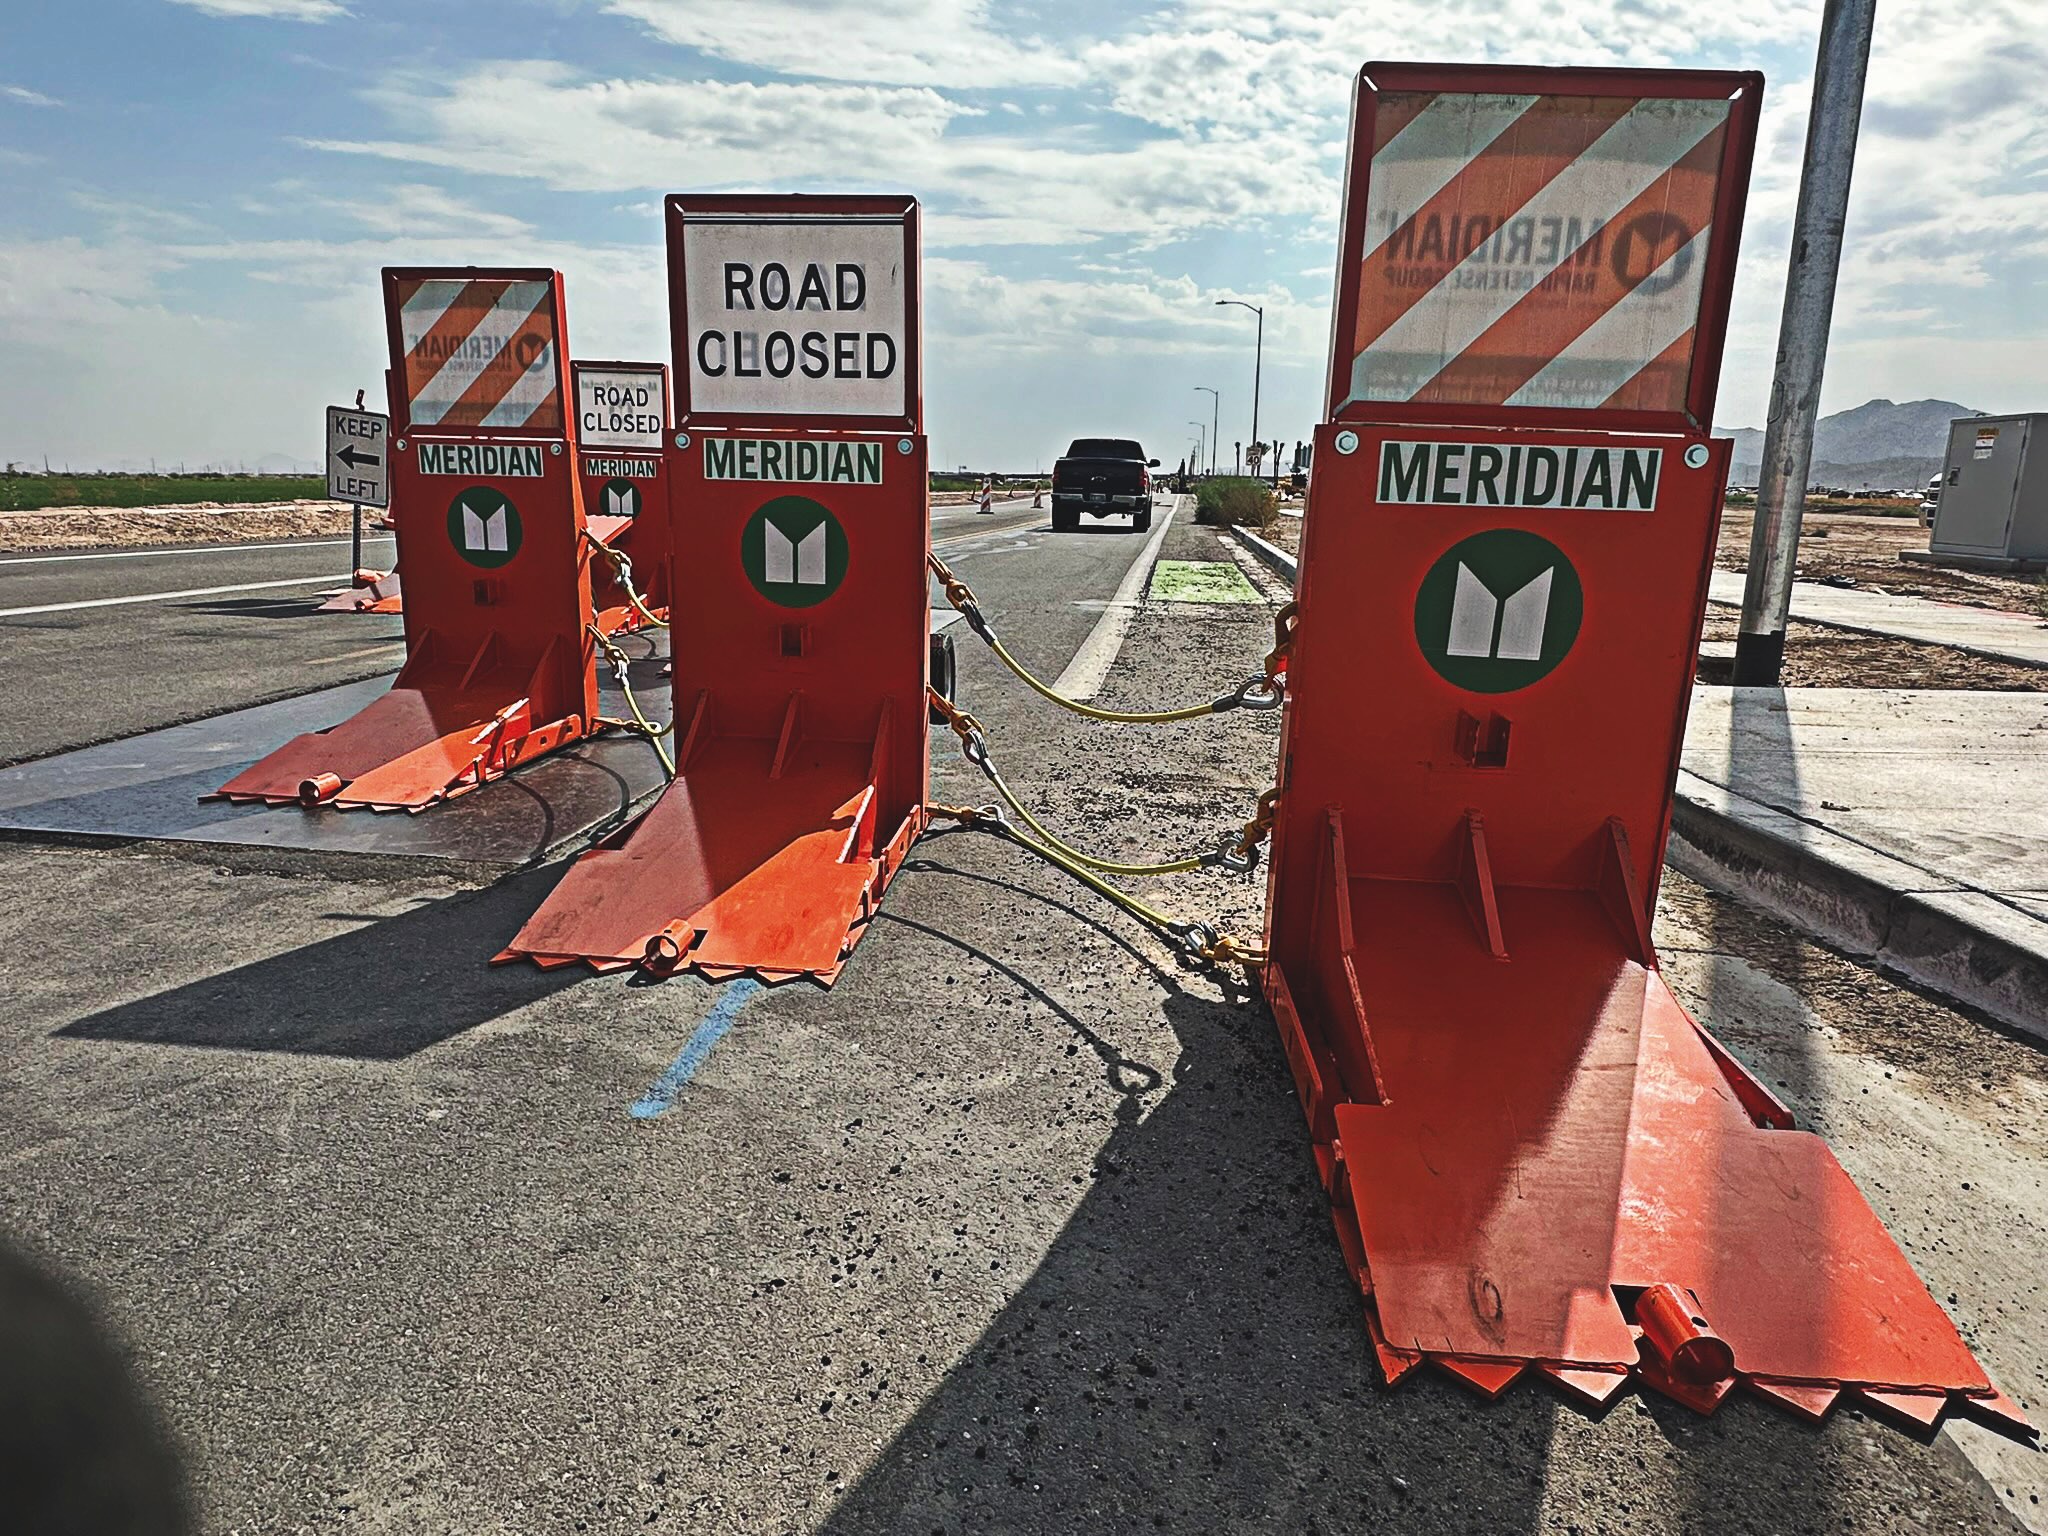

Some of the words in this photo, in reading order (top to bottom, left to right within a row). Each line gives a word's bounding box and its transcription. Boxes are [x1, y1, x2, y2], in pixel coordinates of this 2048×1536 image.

[724, 262, 867, 312] ROAD
[697, 330, 897, 380] CLOSED
[593, 386, 649, 407] ROAD
[335, 416, 383, 440] KEEP
[584, 412, 661, 434] CLOSED
[419, 444, 543, 476] MERIDIAN
[587, 459, 655, 477] MERIDIAN
[705, 439, 881, 484] MERIDIAN
[1247, 455, 1260, 465] 40
[336, 476, 379, 499] LEFT
[1379, 442, 1660, 510] MERIDIAN
